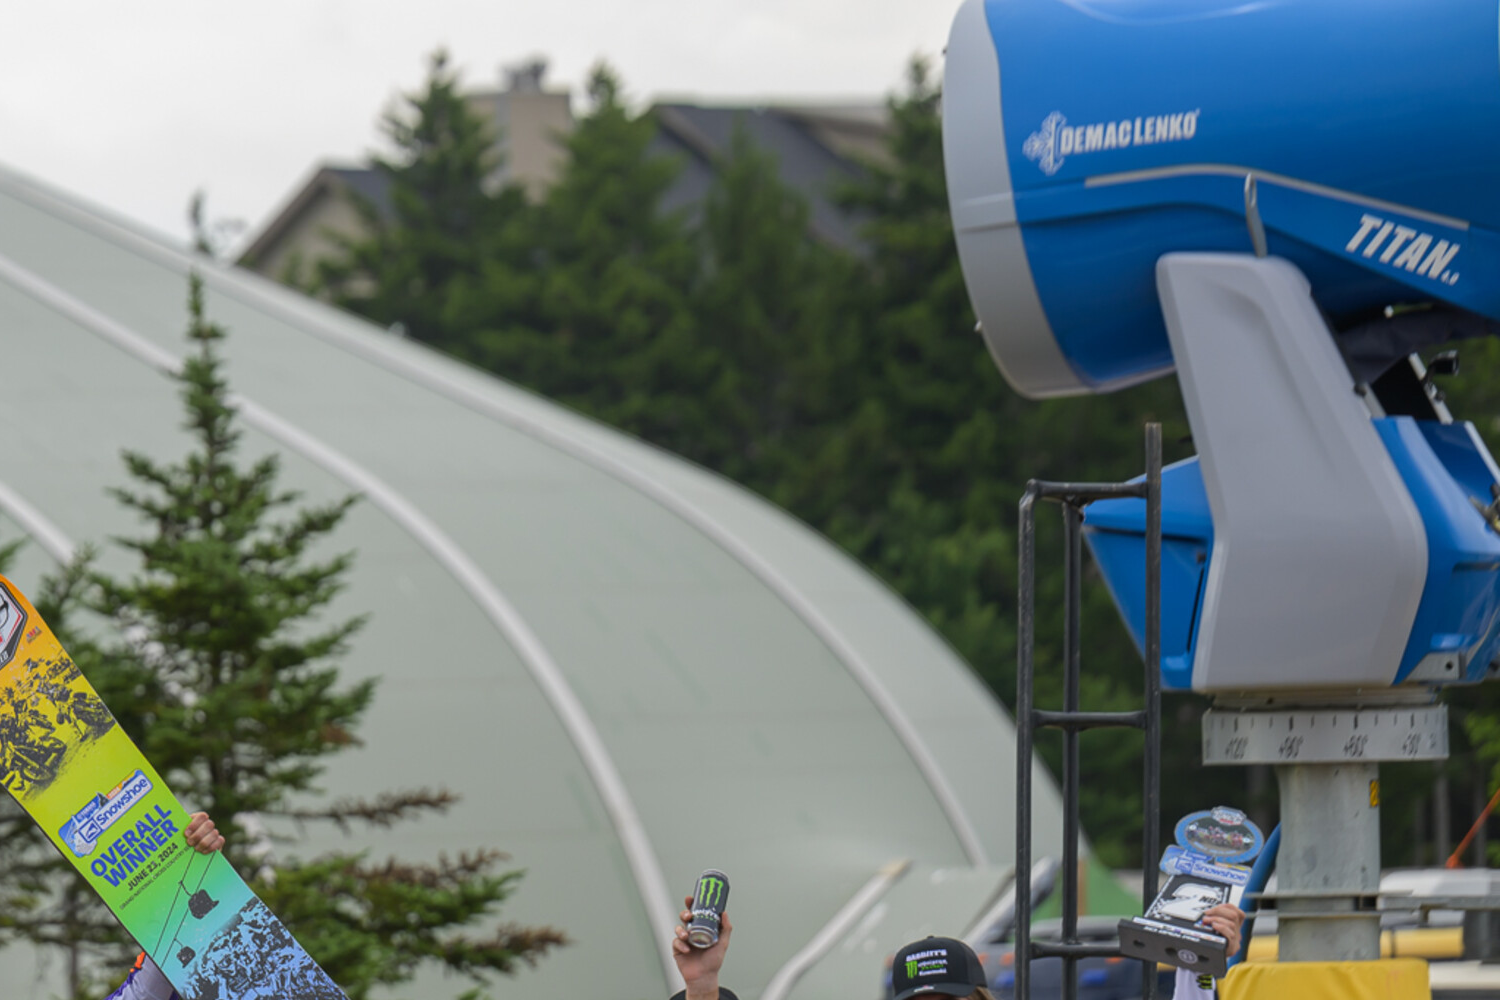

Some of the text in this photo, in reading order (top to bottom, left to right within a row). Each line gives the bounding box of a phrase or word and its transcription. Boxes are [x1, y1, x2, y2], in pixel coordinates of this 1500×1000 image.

[1058, 111, 1198, 155] DEMACLENKO
[1345, 214, 1460, 281] TITAN
[96, 778, 148, 825] Snowshoe
[91, 804, 172, 877] OVERALL
[103, 819, 179, 887] WINNER
[127, 868, 150, 891] JUNE
[157, 842, 179, 863] 2024
[1194, 863, 1247, 881] Snowshoe
